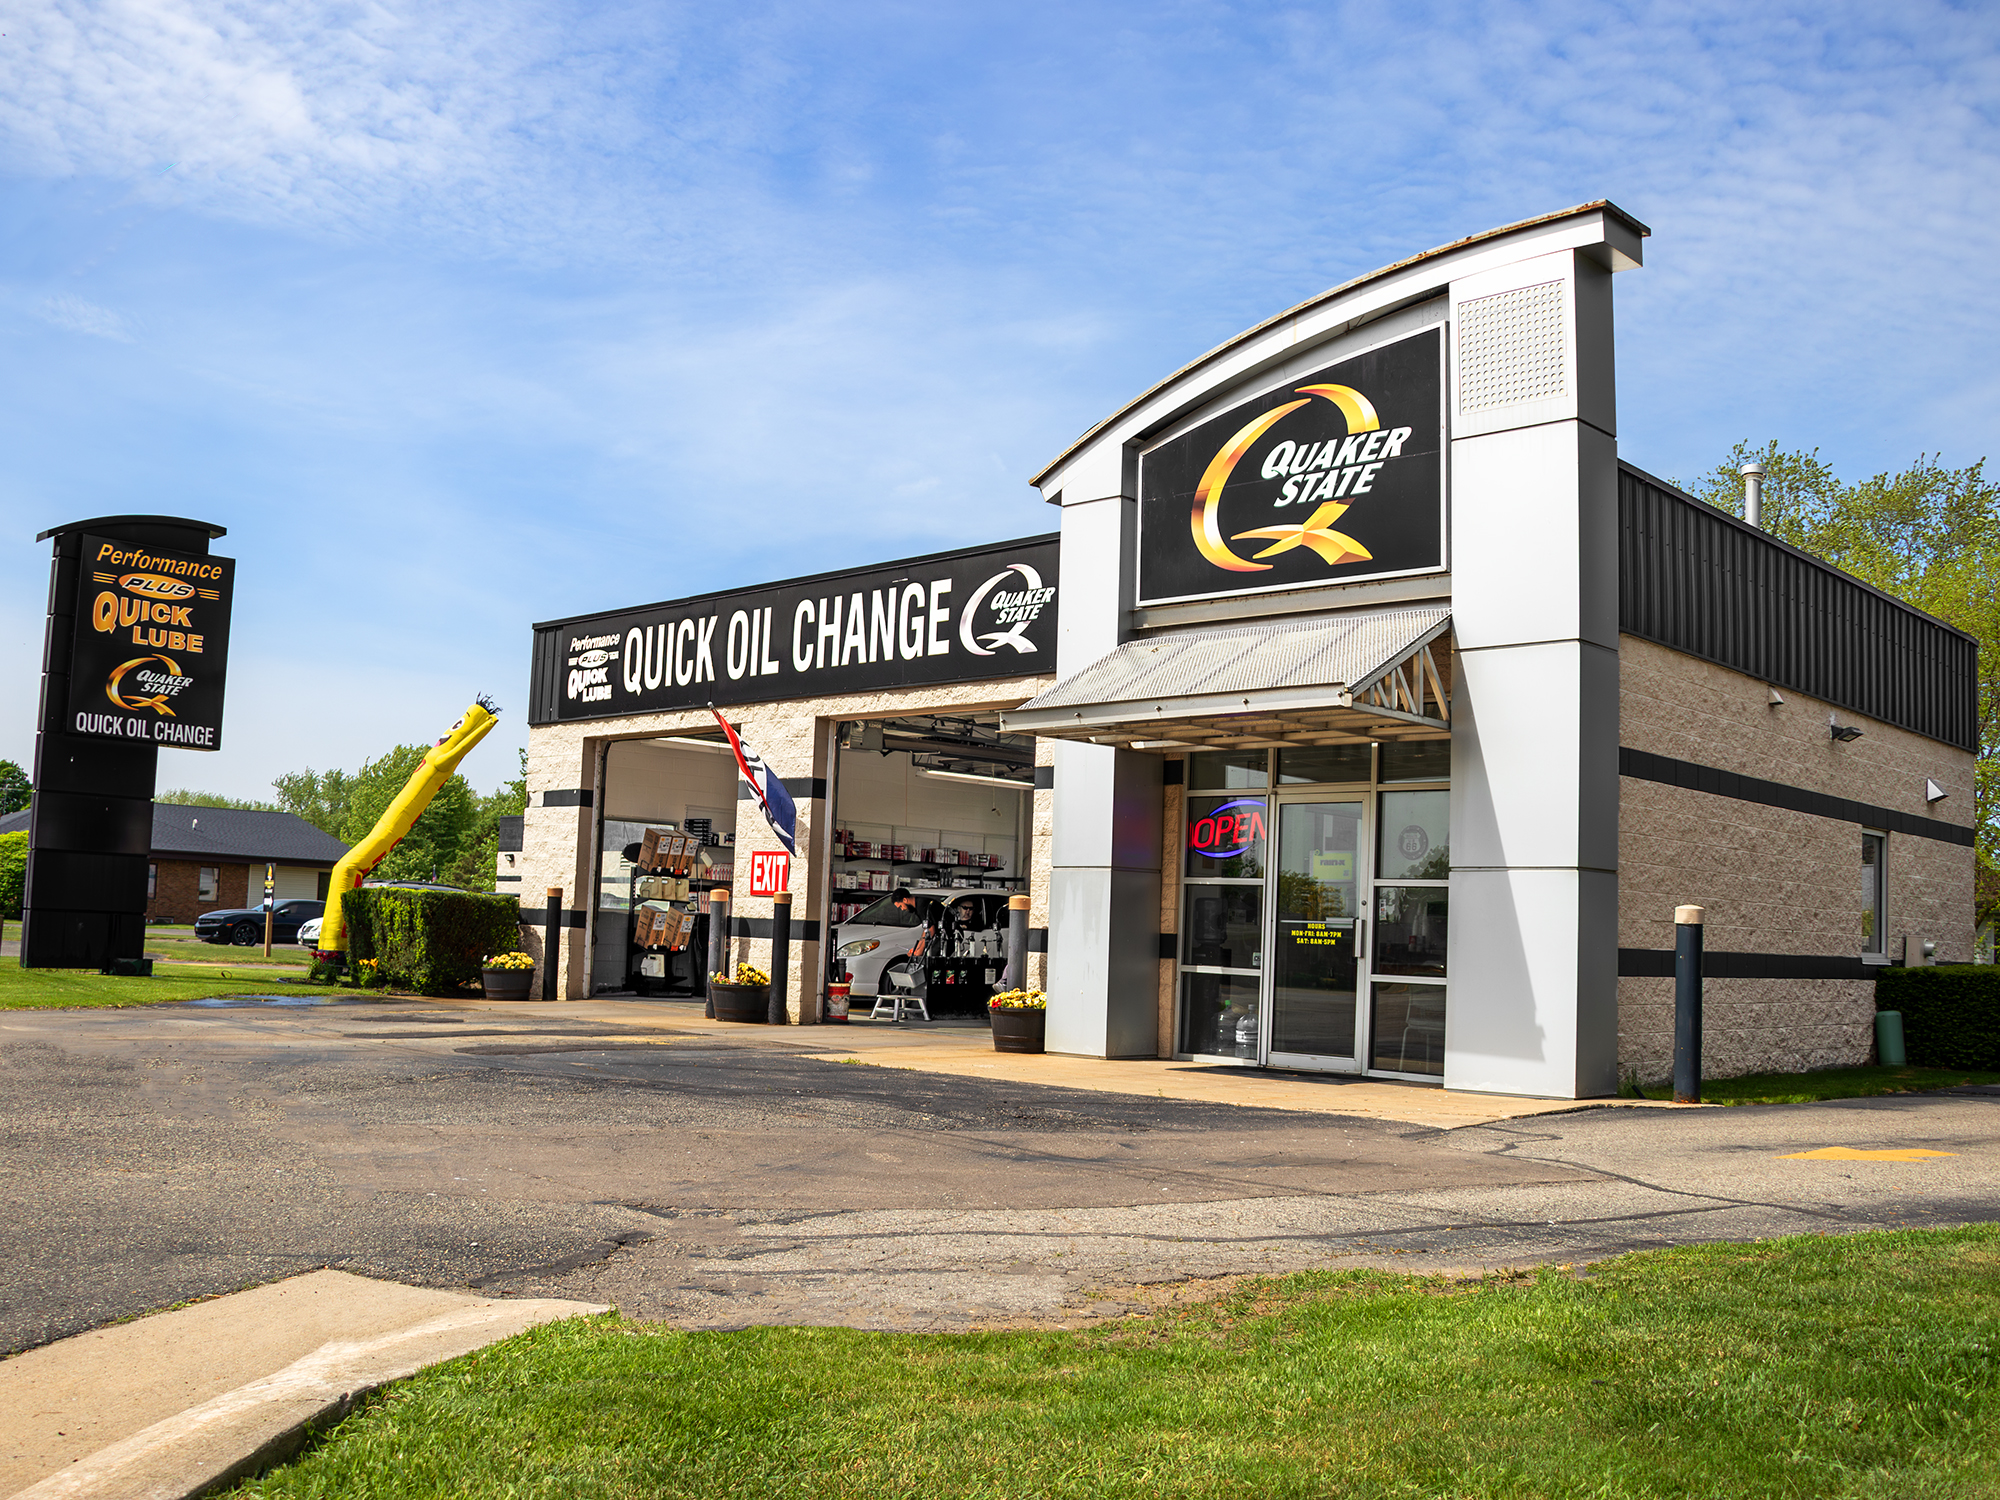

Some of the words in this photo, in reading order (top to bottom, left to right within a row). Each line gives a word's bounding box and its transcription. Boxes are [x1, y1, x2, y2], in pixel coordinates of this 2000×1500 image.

[1261, 426, 1413, 480] QUAKER
[1273, 461, 1385, 508] STATE
[97, 543, 222, 580] Performance
[122, 577, 195, 597] PLUS
[990, 587, 1056, 611] QUAKER
[92, 591, 194, 634] QUICK
[995, 603, 1044, 625] STATE
[132, 625, 204, 653] LUBE
[569, 633, 621, 652] Performance
[623, 616, 717, 696] QUICK
[727, 607, 780, 681] OIL
[792, 577, 954, 672] CHANGE
[580, 653, 608, 664] PLUS
[136, 669, 193, 687] QUAKER
[141, 682, 183, 696] STATE
[567, 667, 608, 700] QUICK
[582, 684, 612, 702] LUBE
[76, 712, 123, 736] QUICK
[126, 718, 150, 739] OIL
[154, 721, 214, 746] CHANGE
[752, 854, 787, 893] EXIT
